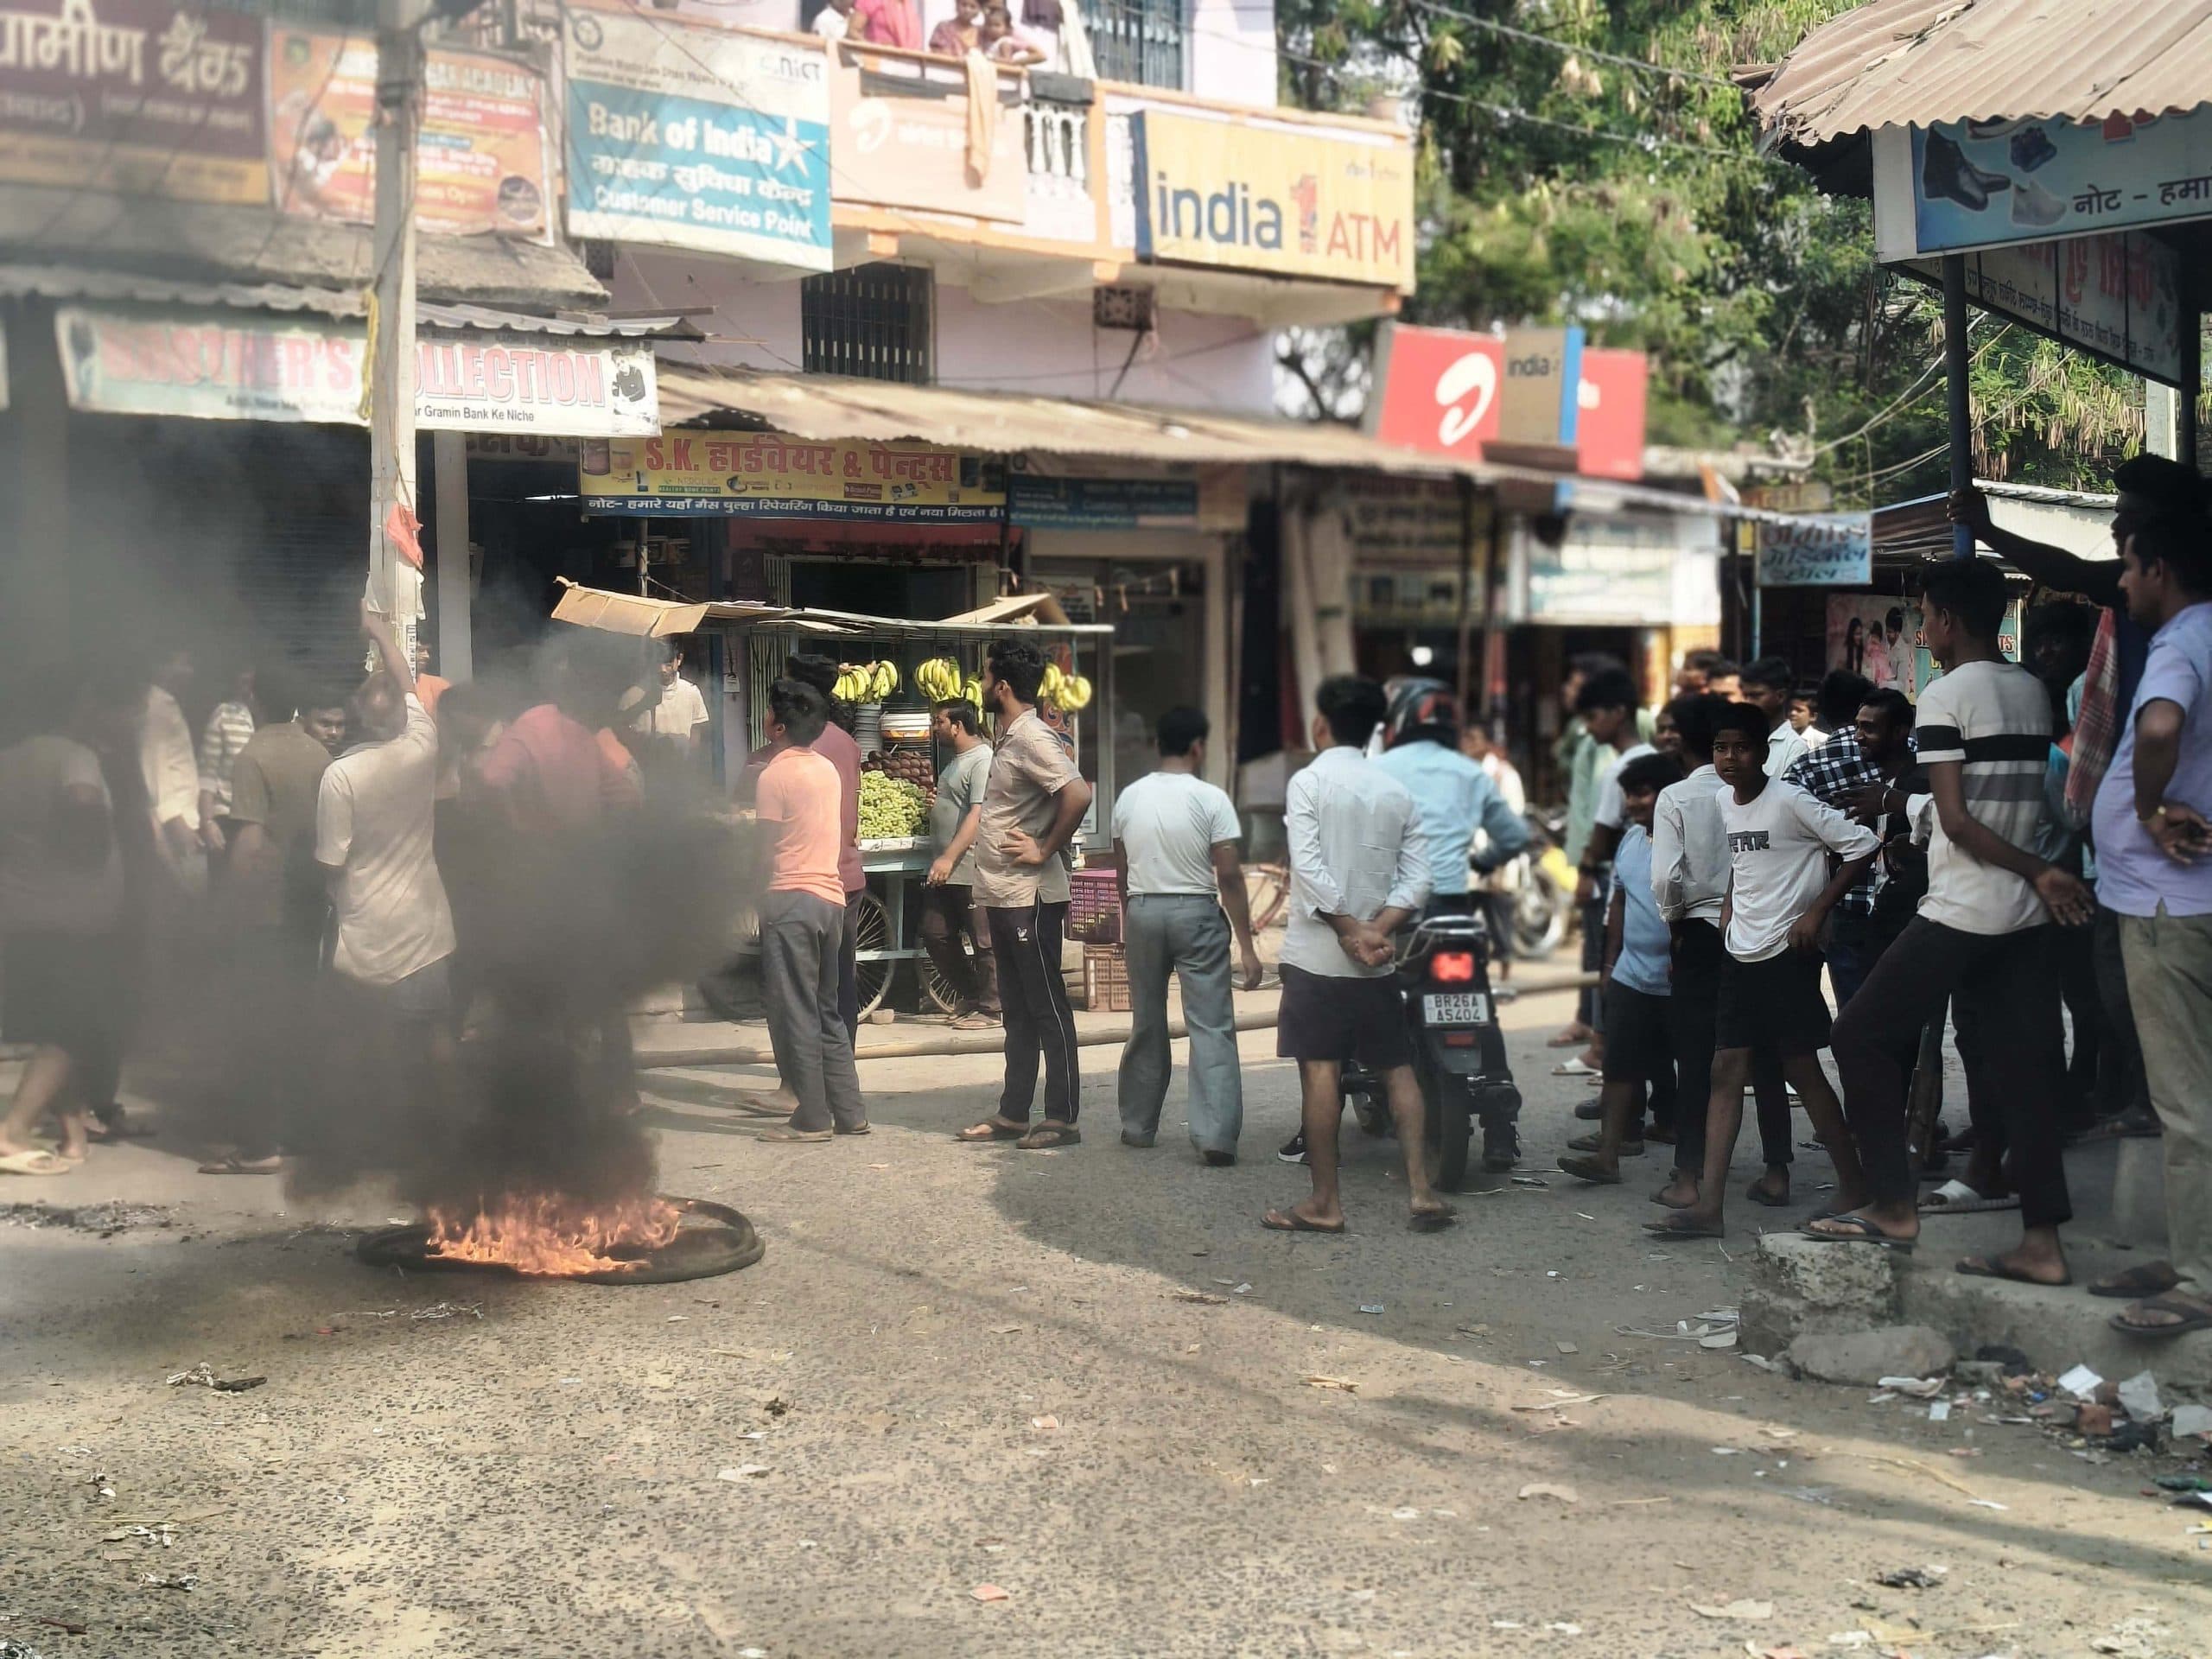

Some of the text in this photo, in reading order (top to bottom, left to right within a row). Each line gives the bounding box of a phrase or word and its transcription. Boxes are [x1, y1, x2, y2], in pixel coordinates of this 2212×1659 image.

[588, 101, 659, 146] Bank
[664, 116, 698, 151] of
[703, 118, 772, 165] India
[594, 184, 812, 238] Customer Service Point
[2072, 183, 2123, 214] नोट
[2158, 175, 2212, 206] हमा
[1157, 171, 1283, 251] india
[1326, 210, 1402, 265] ATM
[423, 404, 461, 419] Gramin
[463, 407, 489, 420] Bank
[492, 408, 505, 421] Ke
[507, 409, 534, 422] Niche
[645, 437, 700, 472] S.K.
[842, 450, 862, 478] &
[627, 497, 662, 510] हमारे
[664, 498, 692, 511] यहाँ
[817, 500, 847, 513] किया
[851, 504, 881, 516] जाता
[886, 505, 894, 518] है
[920, 508, 944, 518] नया
[948, 505, 986, 518] मिलता
[1434, 995, 1480, 1008] BR26A
[1436, 1008, 1482, 1021] A5404
